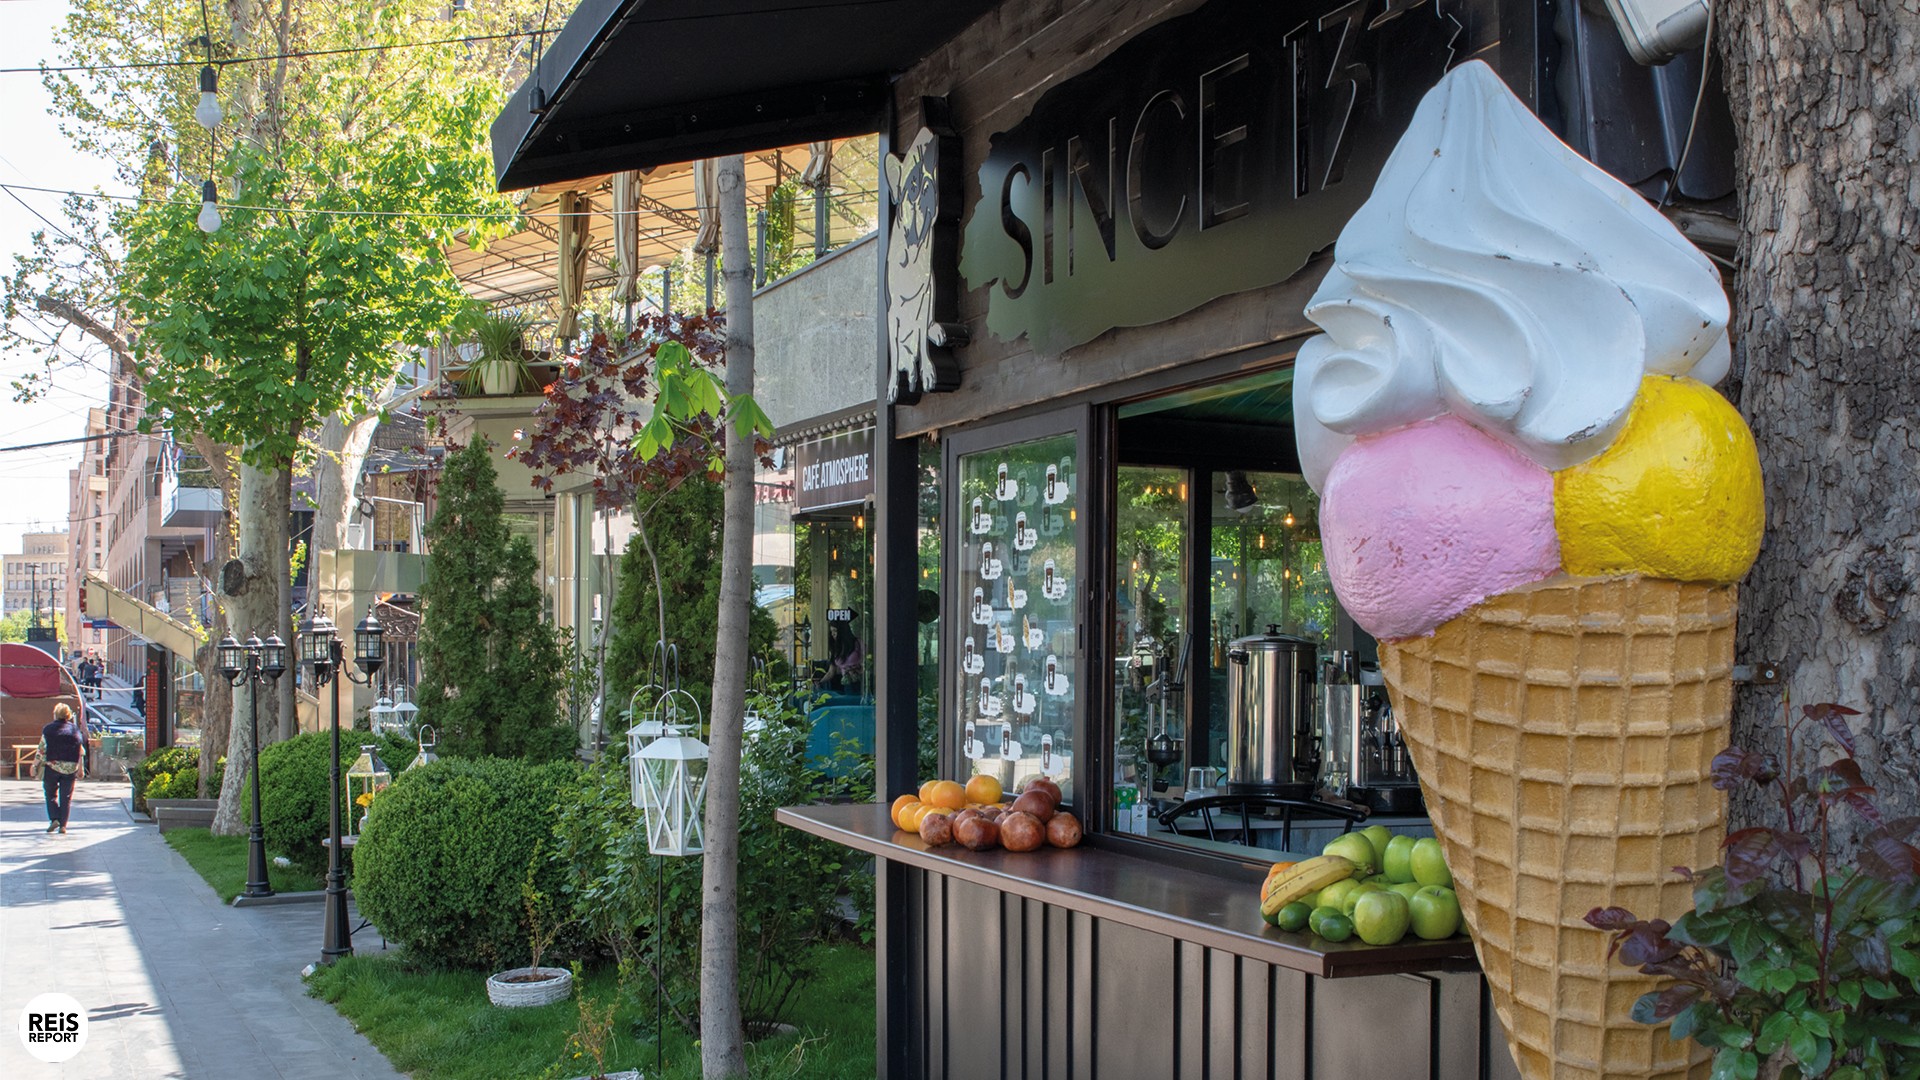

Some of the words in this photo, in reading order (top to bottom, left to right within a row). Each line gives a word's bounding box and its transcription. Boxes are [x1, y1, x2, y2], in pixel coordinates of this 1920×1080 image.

[1000, 52, 1251, 299] SINCE
[803, 458, 820, 491] CAFÉ
[821, 453, 869, 488] ATMOSPHERE
[828, 610, 851, 621] OPEN
